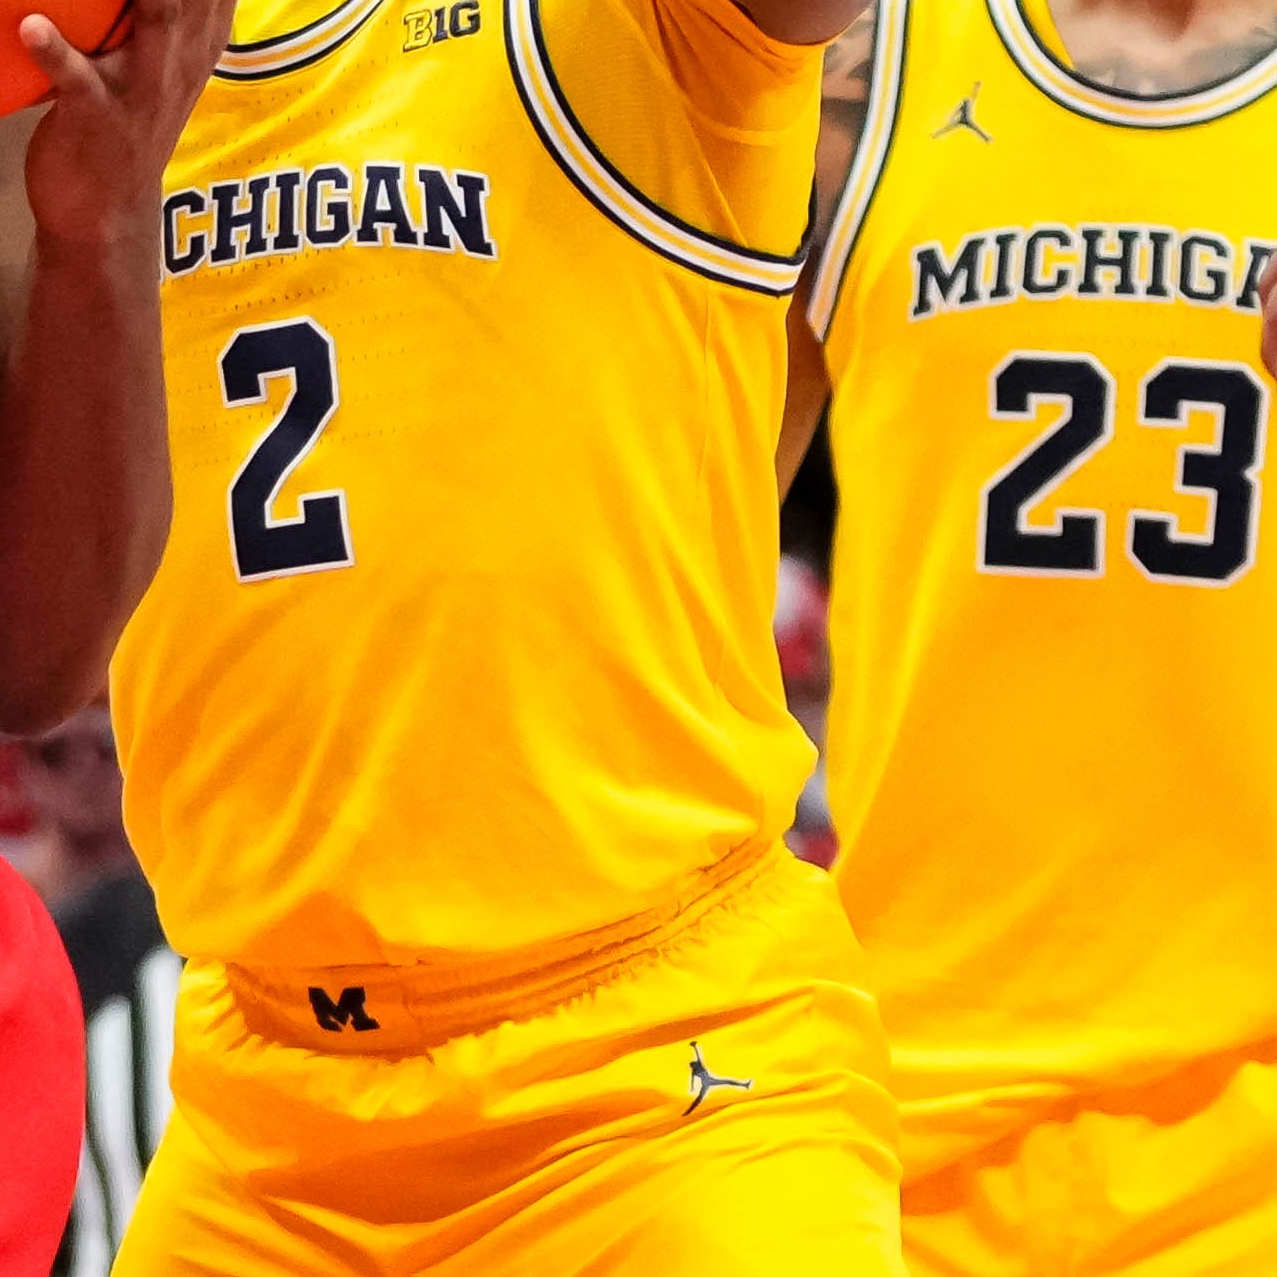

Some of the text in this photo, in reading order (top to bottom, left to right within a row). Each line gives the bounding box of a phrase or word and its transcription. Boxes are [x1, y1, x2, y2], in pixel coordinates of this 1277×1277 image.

[160, 158, 499, 280] CHIGAN
[217, 316, 355, 584] 2
[978, 350, 1267, 588] 23
[306, 985, 382, 1033] M
